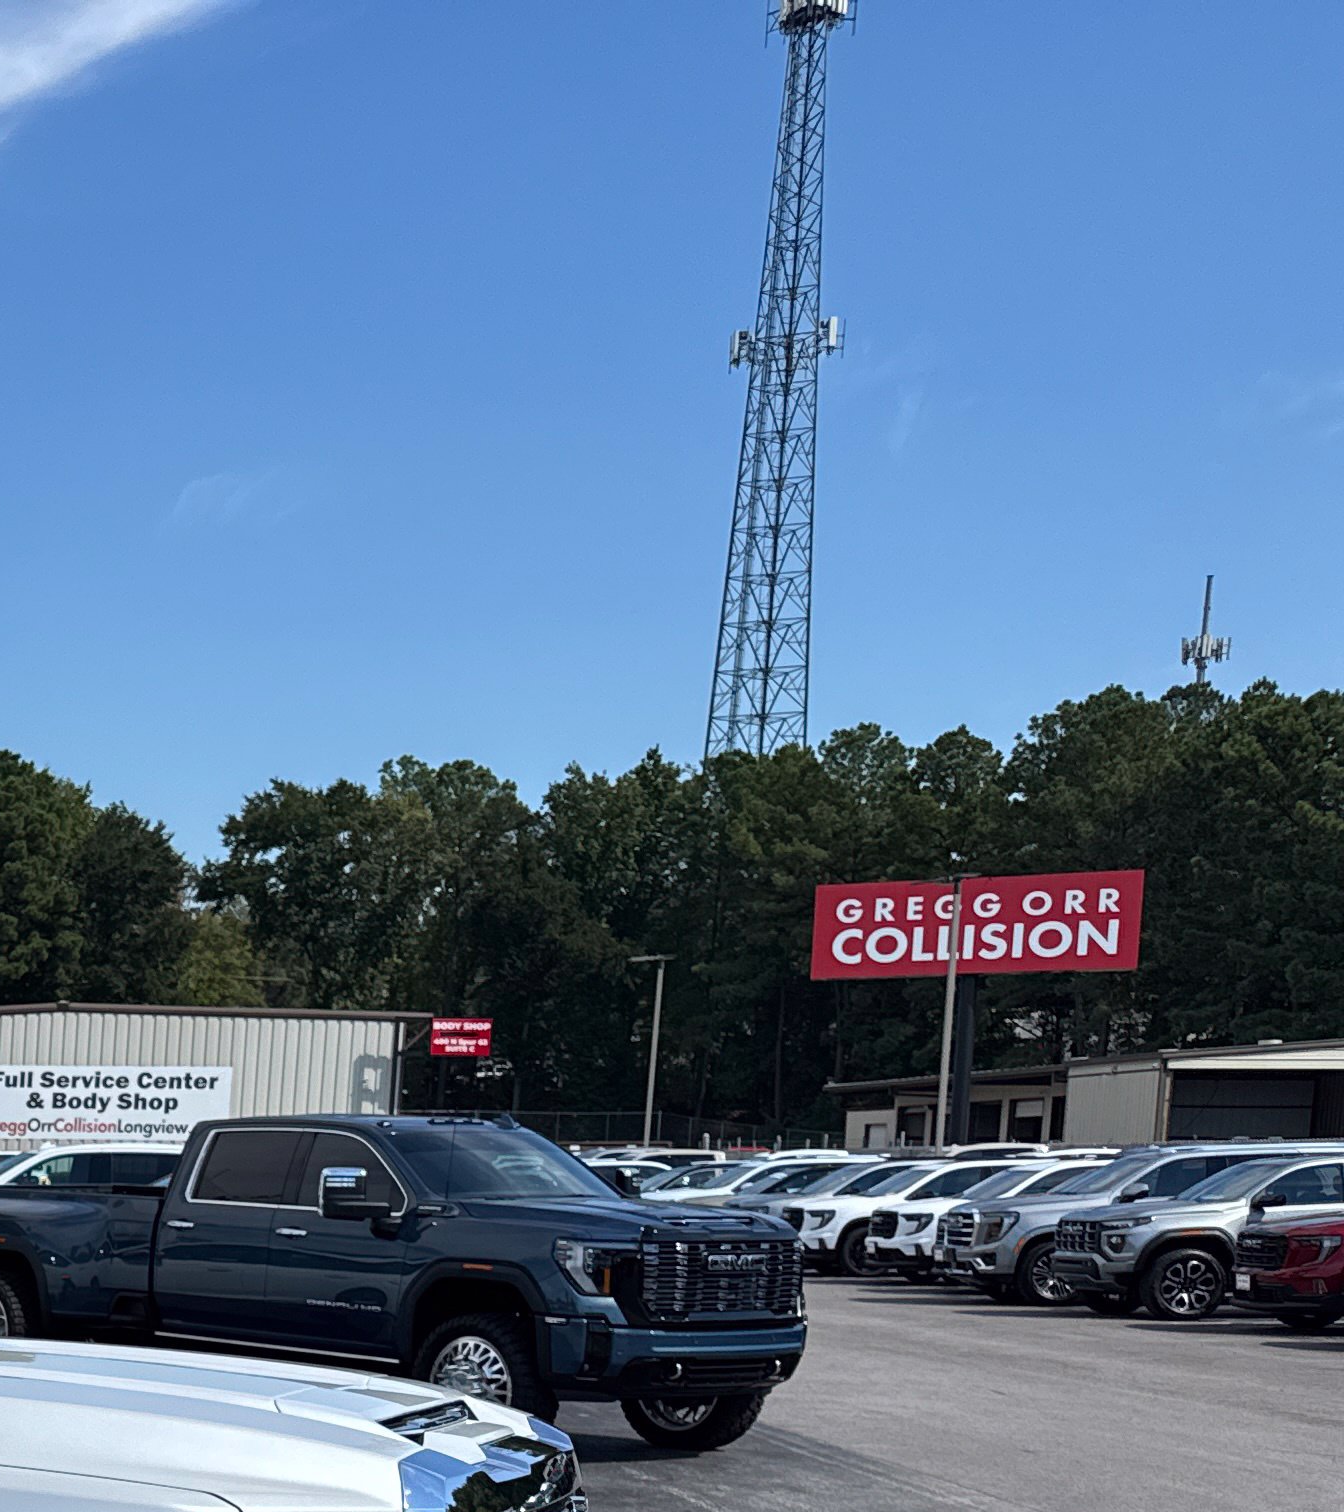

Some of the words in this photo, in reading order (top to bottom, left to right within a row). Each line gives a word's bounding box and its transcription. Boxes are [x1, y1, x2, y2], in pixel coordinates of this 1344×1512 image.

[836, 893, 1001, 923] GREGG
[1022, 888, 1120, 916] ORR
[832, 919, 1119, 964] COLLISION
[433, 1022, 462, 1031] BODY
[39, 1072, 130, 1089] Service
[137, 1073, 219, 1090] Center
[26, 1093, 44, 1108] &
[52, 1092, 109, 1113] Body
[117, 1093, 178, 1113] Shop
[708, 1254, 767, 1271] GMC
